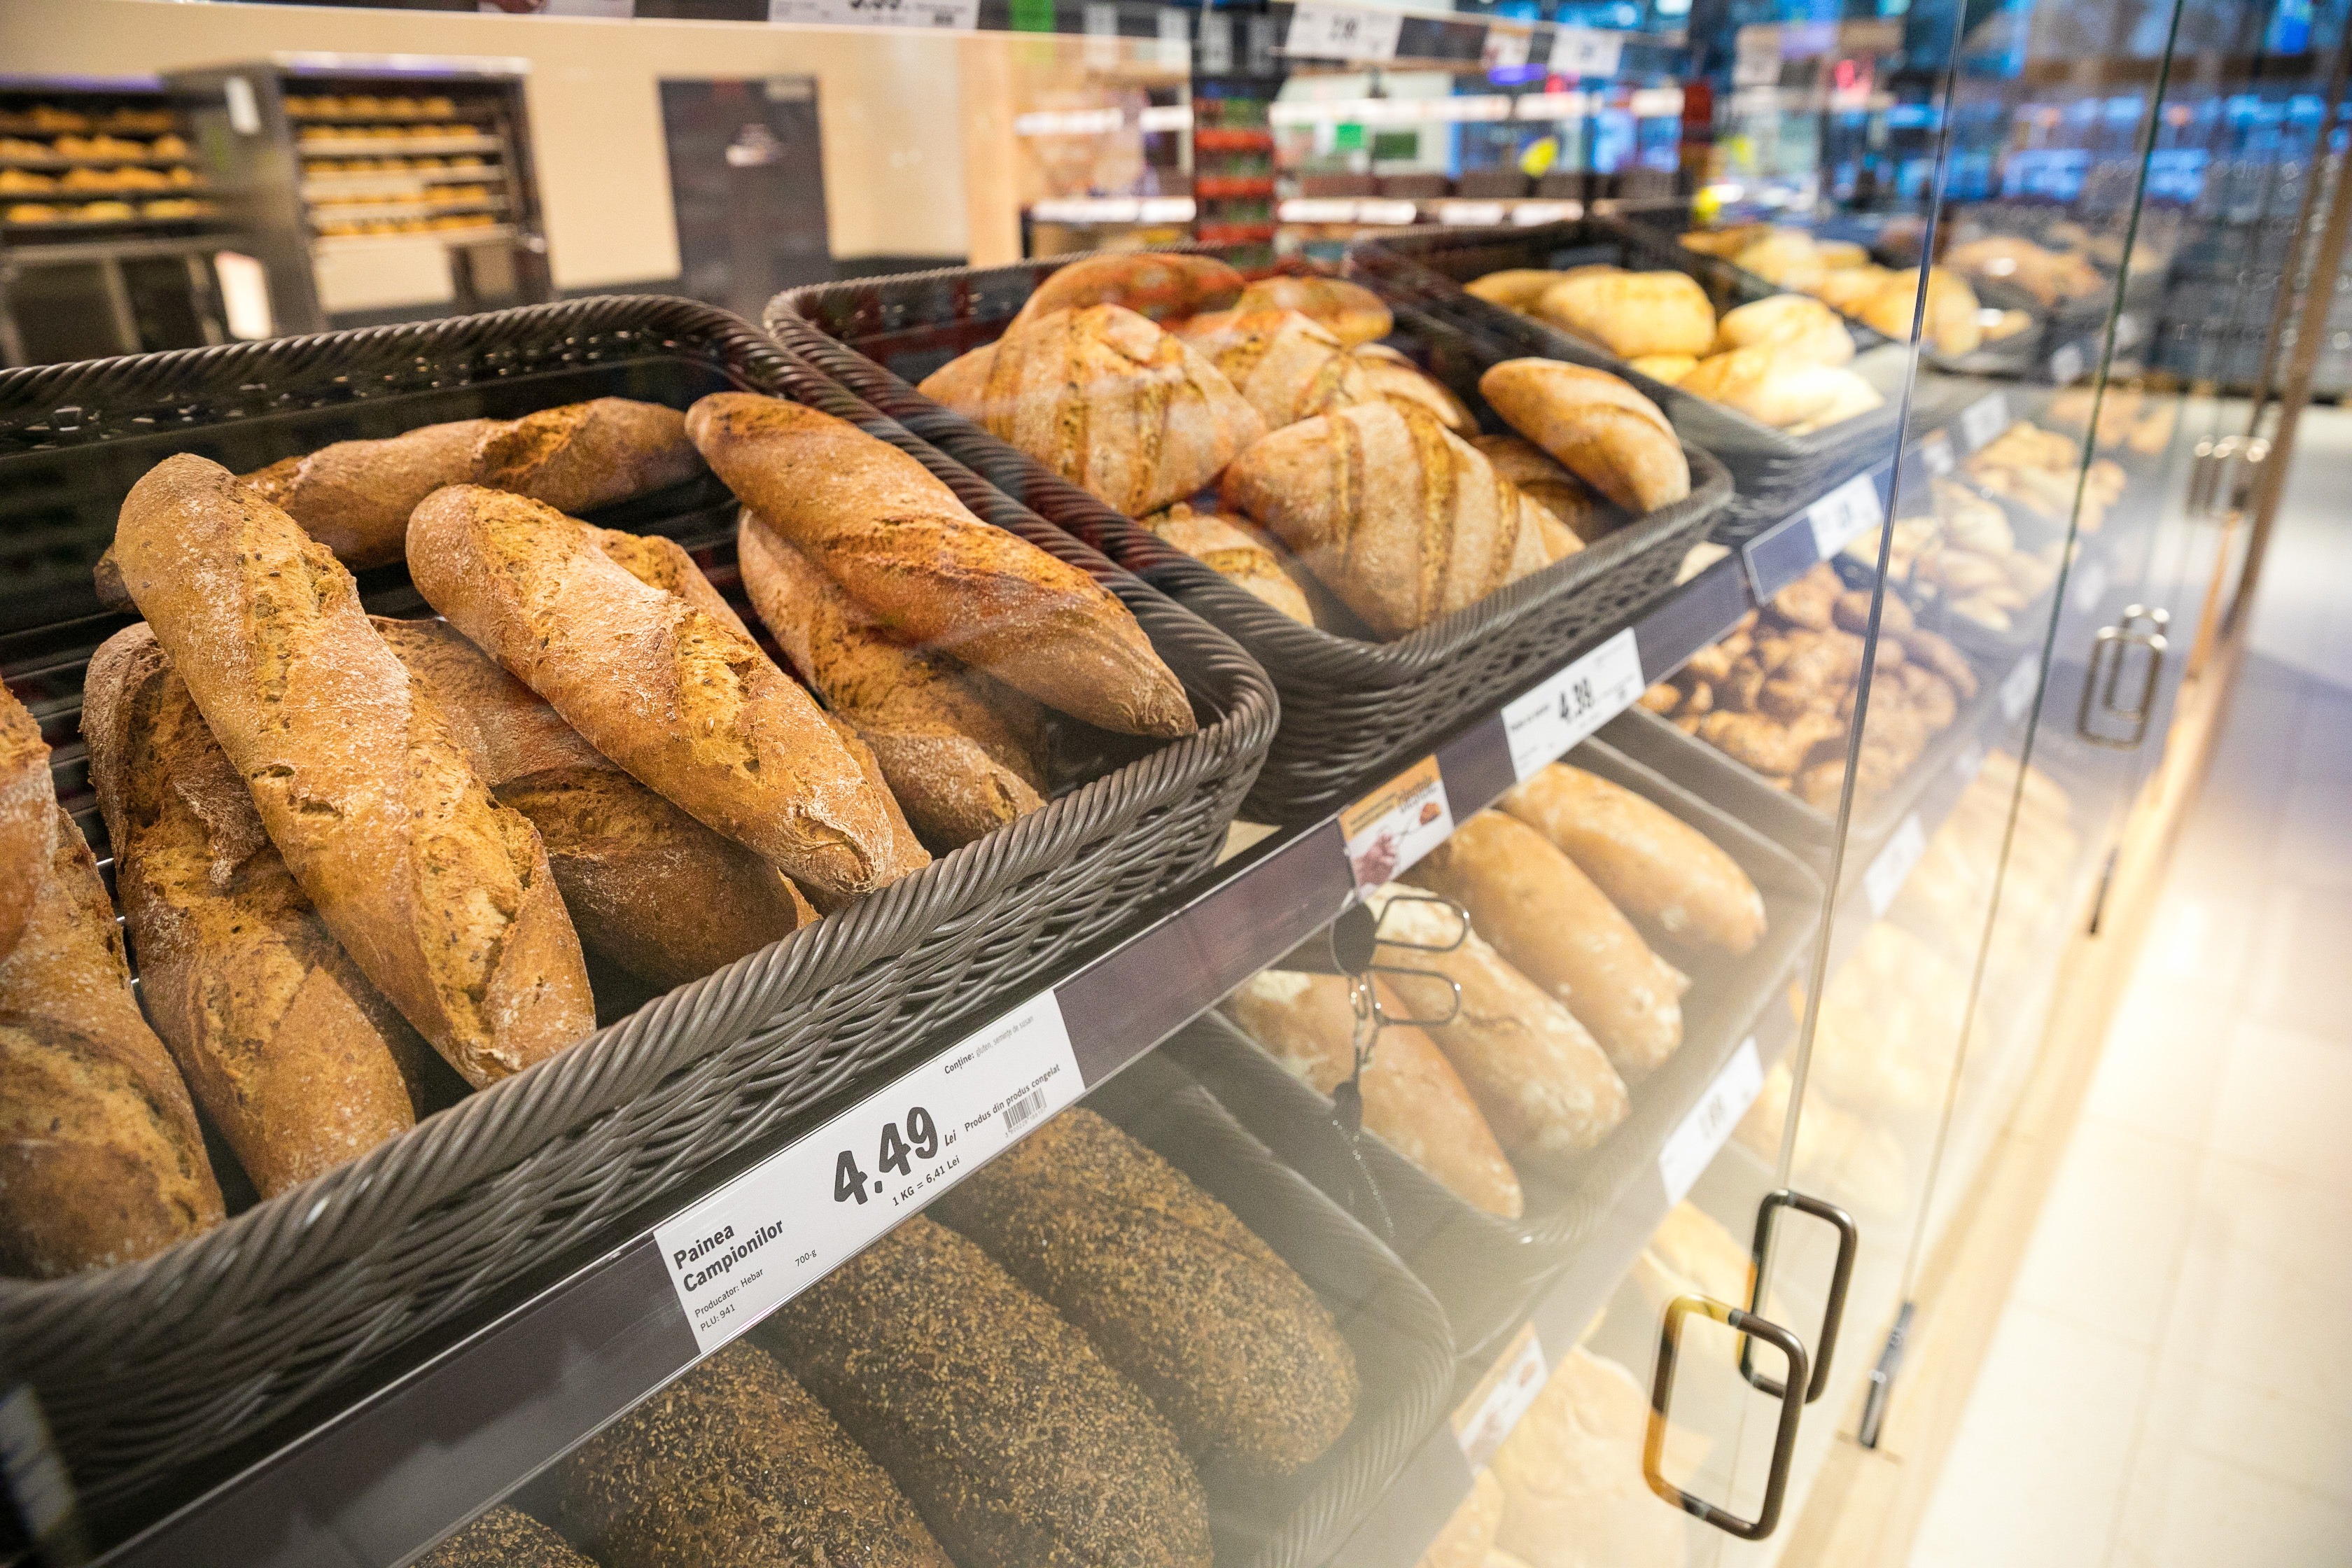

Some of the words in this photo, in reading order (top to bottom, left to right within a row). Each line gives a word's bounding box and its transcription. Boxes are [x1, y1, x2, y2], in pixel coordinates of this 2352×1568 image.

[945, 1053, 974, 1074] Conține:
[976, 1042, 993, 1058] gluten,
[1012, 1024, 1019, 1032] de
[1020, 1016, 1034, 1029] susan
[964, 1111, 991, 1132] Produs
[993, 1102, 1004, 1114] din
[1006, 1085, 1030, 1106] produs
[1031, 1064, 1060, 1088] congelat
[834, 1107, 938, 1205] 4.49
[944, 1130, 957, 1147] Lei
[892, 1196, 899, 1206] 1
[901, 1186, 915, 1201] KG
[926, 1166, 946, 1184] 6,41
[946, 1155, 960, 1170] Lei
[673, 1225, 735, 1270] Painea
[683, 1220, 783, 1292] Campionilor
[794, 1249, 817, 1267] 700-g
[694, 1285, 740, 1318] Producator:
[741, 1268, 764, 1288] Hebar
[700, 1315, 720, 1331] PLU:
[720, 1303, 736, 1320] 941
